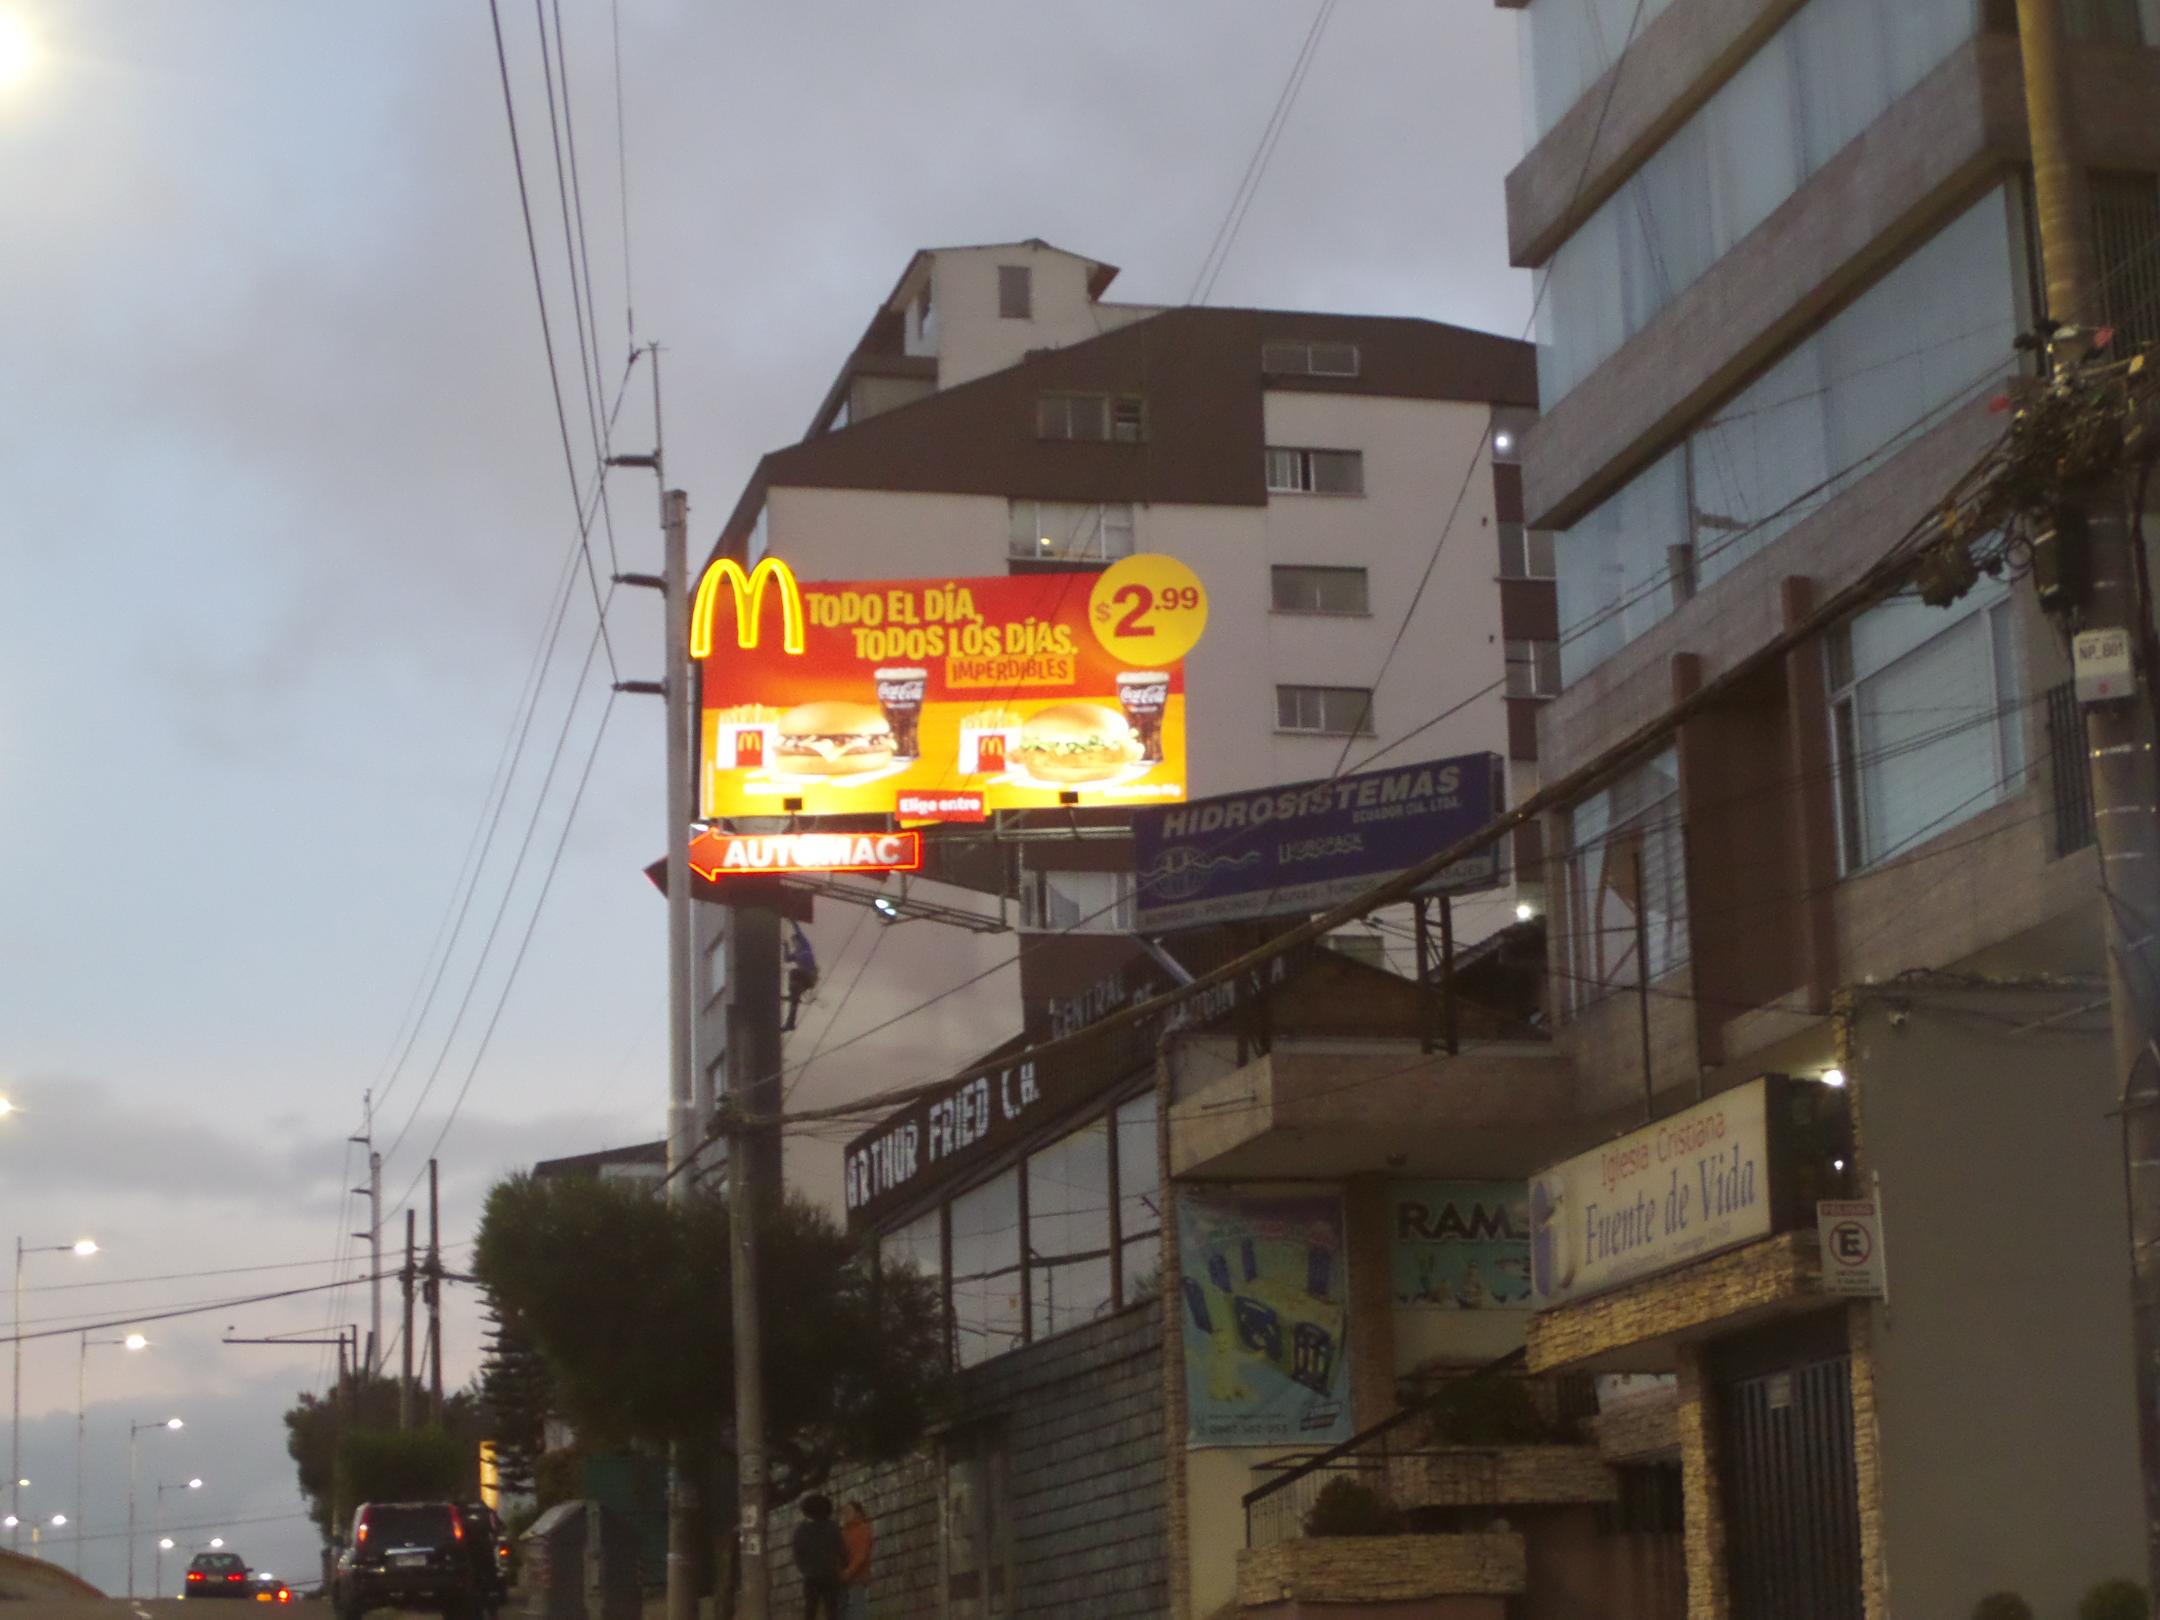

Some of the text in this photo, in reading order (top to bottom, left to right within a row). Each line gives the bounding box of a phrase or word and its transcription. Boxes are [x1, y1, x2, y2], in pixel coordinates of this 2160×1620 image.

[806, 581, 982, 628] TODO EL DÍA,
[853, 616, 1078, 661] TODOS LOS DÍAS.
[952, 656, 1069, 684] IMPERDIBLES
[900, 798, 980, 816] Elige entre
[1163, 766, 1460, 838] HIDROSISTEMAS
[723, 833, 900, 869] AUTOMAC
[928, 1076, 989, 1164] FRIED
[1601, 1109, 1726, 1193] Iglesia Cristiana
[1585, 1142, 1756, 1266] Fuente de Vida
[1840, 1229, 1863, 1257] E
